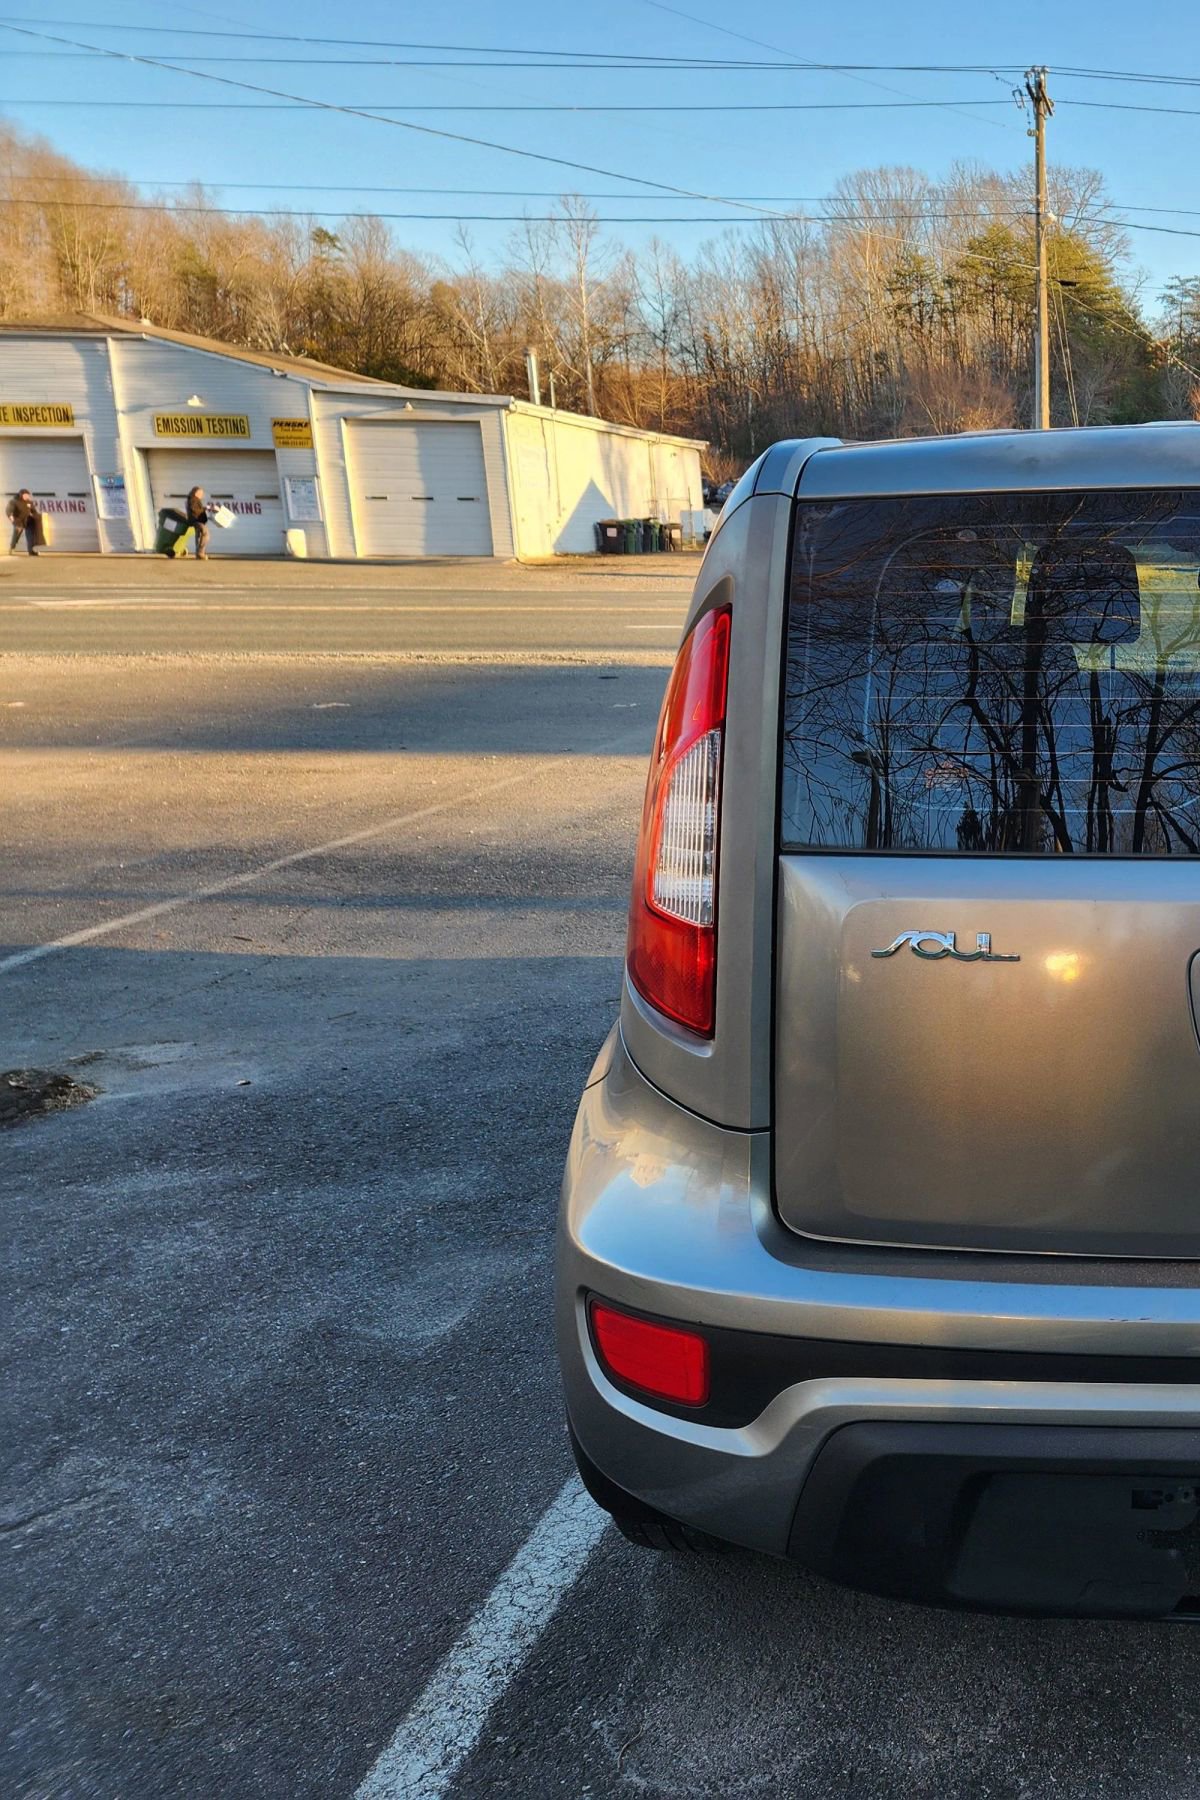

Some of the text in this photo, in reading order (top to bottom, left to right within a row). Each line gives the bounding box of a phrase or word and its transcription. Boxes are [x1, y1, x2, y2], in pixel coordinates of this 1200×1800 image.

[12, 406, 70, 423] INSPECTION
[156, 417, 246, 434] EMISSION TESTING
[871, 929, 1021, 962] SOUL
